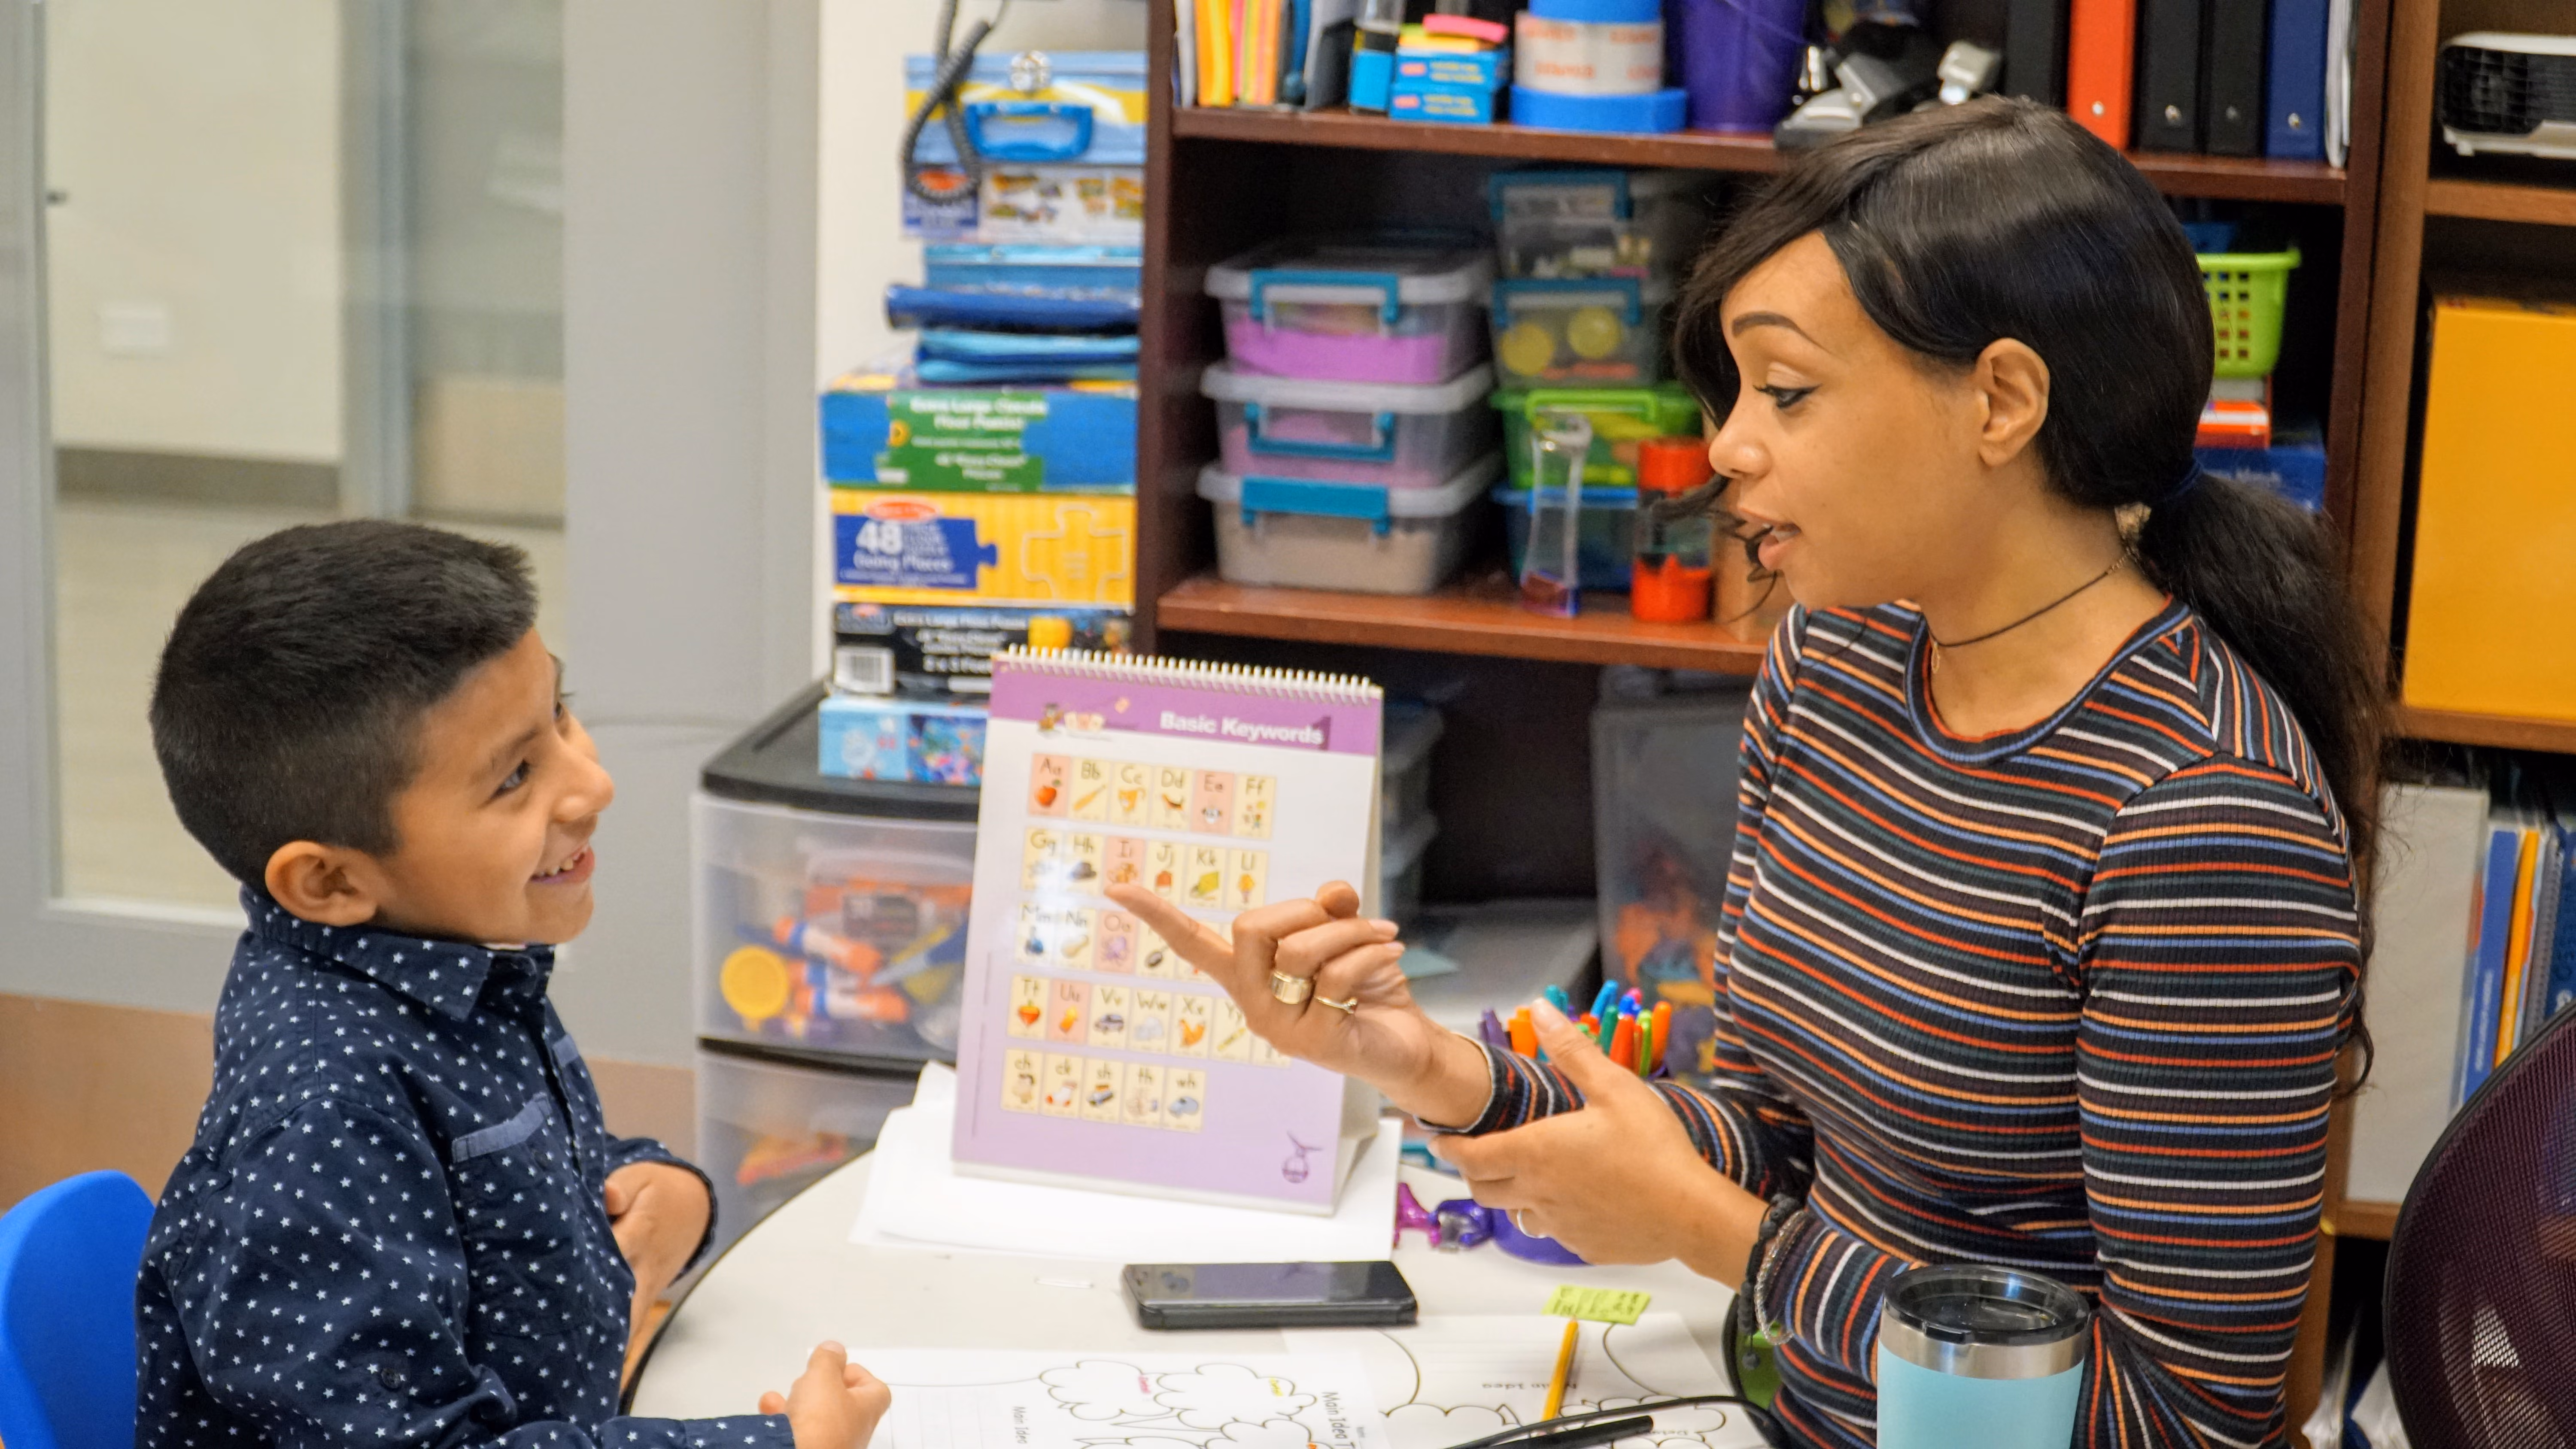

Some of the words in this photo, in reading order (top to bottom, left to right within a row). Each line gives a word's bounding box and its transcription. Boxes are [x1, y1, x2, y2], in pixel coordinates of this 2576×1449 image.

[856, 518, 902, 555] 48
[1160, 711, 1217, 734] Basic
[1221, 716, 1324, 744] Keywords
[1039, 757, 1061, 776] Aa
[1081, 761, 1100, 779] Bb
[1121, 764, 1143, 785] Cc
[1161, 771, 1184, 789] Dd
[1204, 774, 1224, 792] Ee
[1246, 778, 1265, 794] Ff
[1030, 830, 1055, 856] Gg
[1074, 835, 1094, 854] Hh
[1197, 848, 1216, 866] Kk
[1023, 979, 1039, 996] Tt
[1060, 983, 1080, 1002] Uu
[1100, 988, 1122, 1006] Vv
[1137, 991, 1166, 1010] Ww
[1182, 996, 1203, 1015] Xx
[1014, 1053, 1030, 1070] ch
[1138, 1067, 1152, 1084] th
[1176, 1073, 1196, 1088] wh
[1013, 1406, 1029, 1425] Main
[1321, 1391, 1344, 1415] Main
[1015, 1427, 1030, 1444] Idea
[1328, 1418, 1351, 1439] Idea
